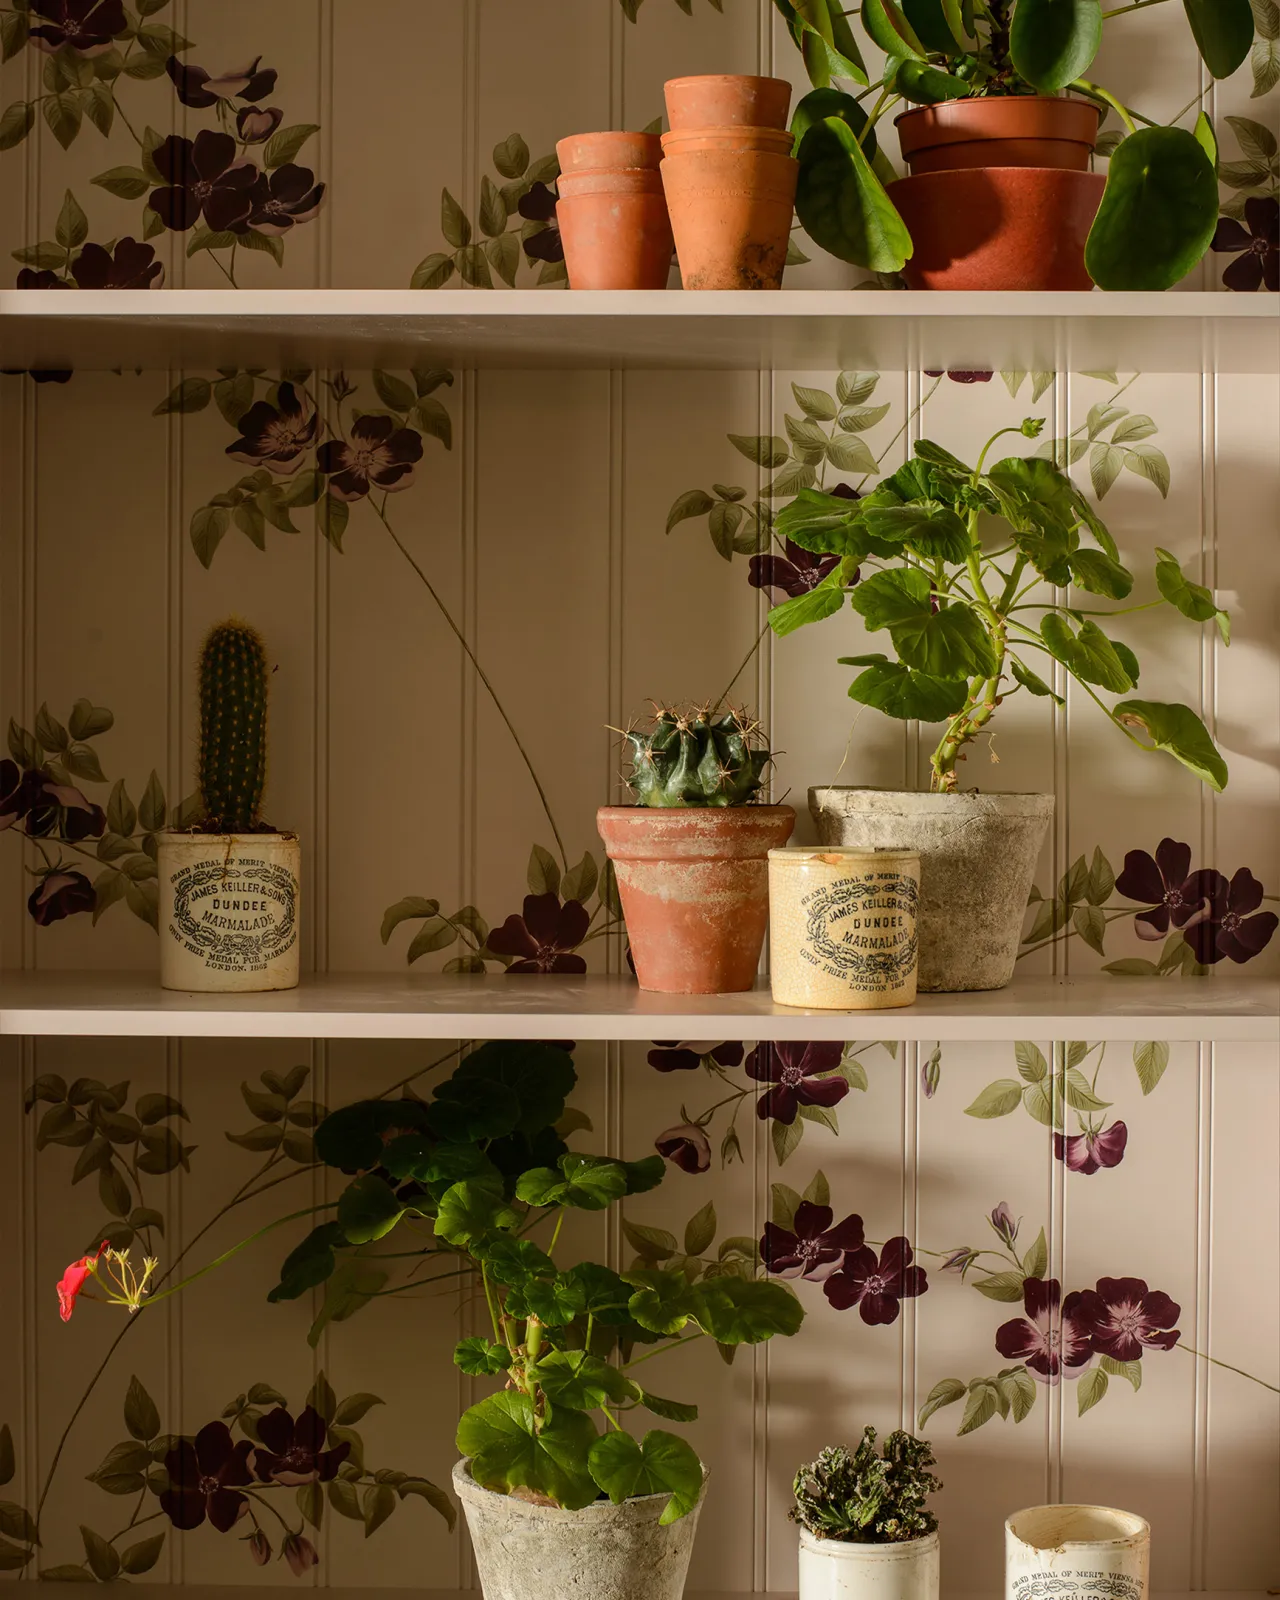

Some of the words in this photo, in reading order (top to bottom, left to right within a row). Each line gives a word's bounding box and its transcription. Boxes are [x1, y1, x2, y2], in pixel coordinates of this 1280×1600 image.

[193, 860, 221, 871] MEDAL
[239, 859, 265, 868] MERIT
[191, 884, 218, 902] JAMES
[801, 887, 827, 906] GRAND
[831, 876, 861, 889] MEDAL
[213, 899, 267, 911] DUNDEE
[829, 902, 859, 923] JAMES
[202, 911, 275, 931] MARMALADE
[854, 916, 903, 929] DUNDEE
[169, 924, 184, 943] ONLY
[184, 941, 205, 957] PRIZE
[208, 952, 239, 964] MEDAL
[243, 955, 260, 964] FOR
[842, 928, 910, 949] MARMALADE
[800, 948, 821, 966] ONLY
[822, 964, 848, 980] PRIZE
[852, 974, 881, 984] MEDAL
[885, 973, 899, 983] FOR
[1031, 1571, 1058, 1580] MEDAL
